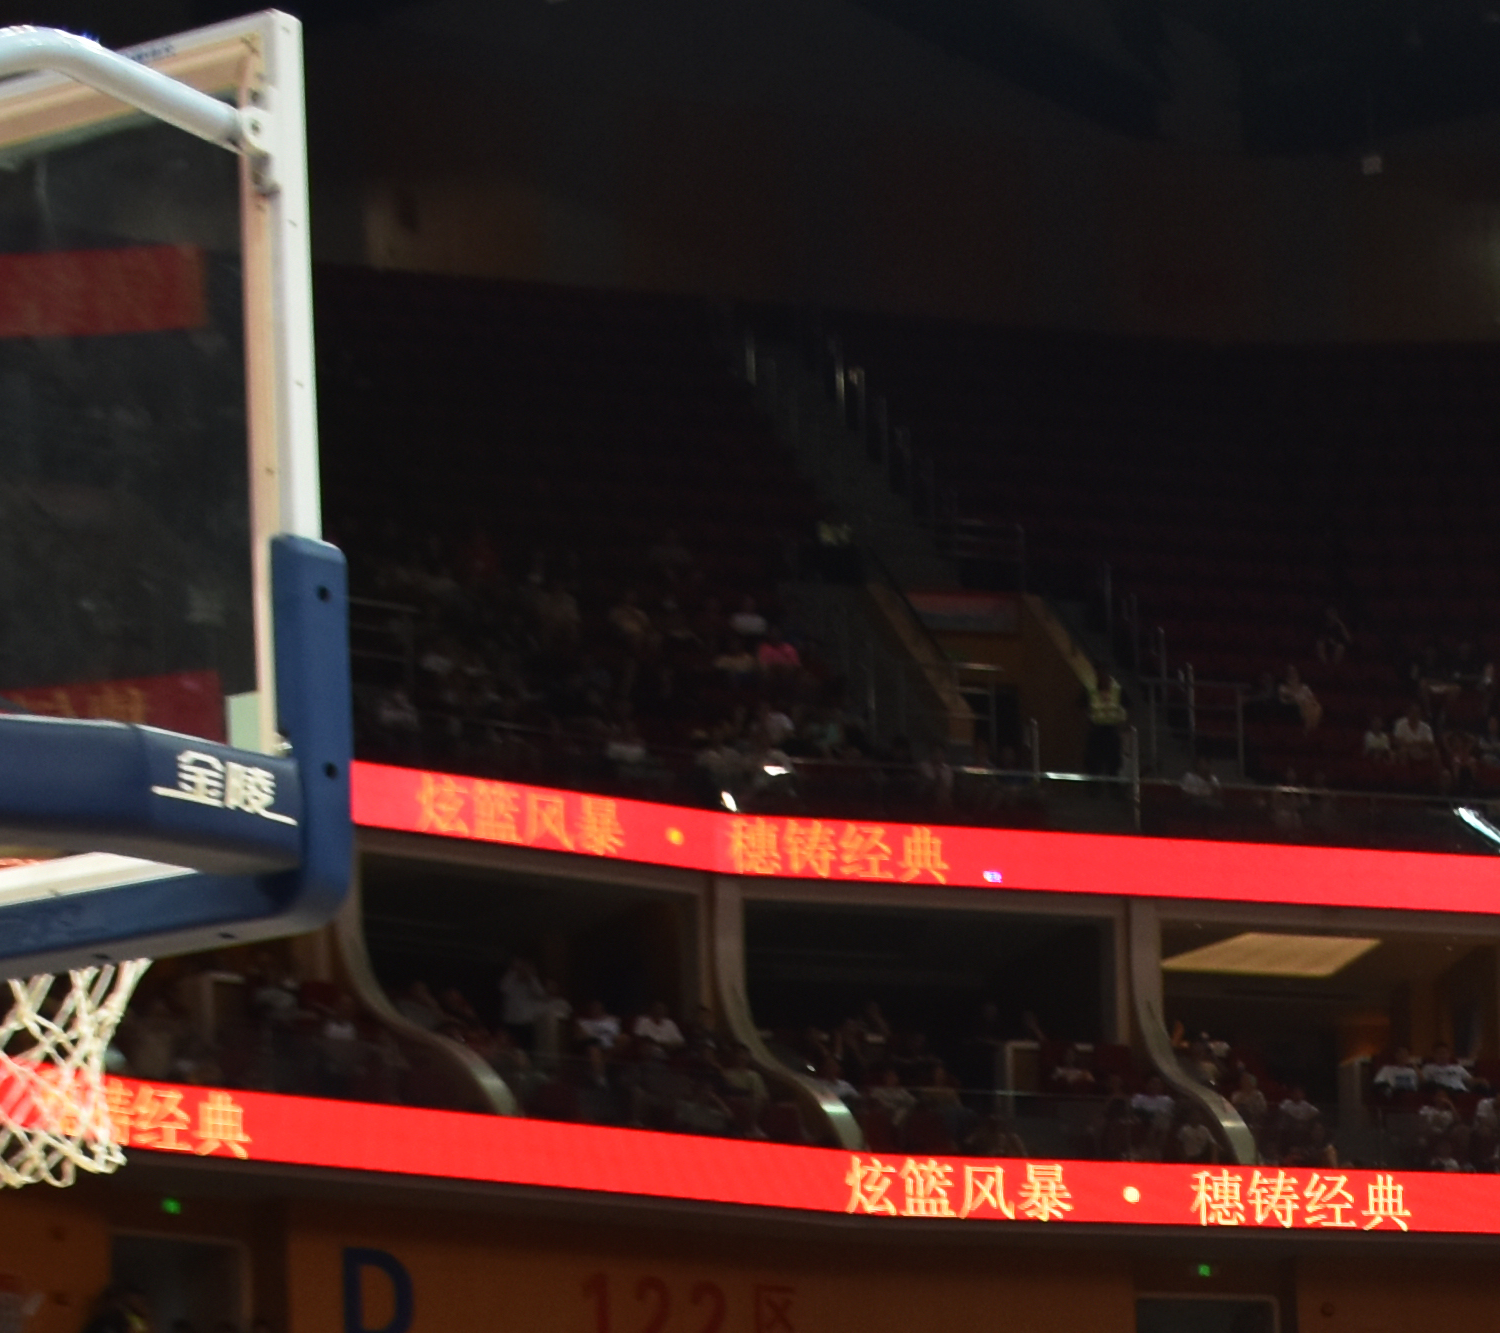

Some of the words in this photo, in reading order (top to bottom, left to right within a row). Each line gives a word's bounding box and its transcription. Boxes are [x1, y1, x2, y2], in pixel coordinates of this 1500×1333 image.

[151, 749, 298, 826] 金陵
[417, 774, 627, 858] 炫篮风暴
[728, 816, 951, 887] 穗铸经典
[844, 1154, 1074, 1223] 炫篮风暴
[1190, 1168, 1413, 1233] 穗铸经典
